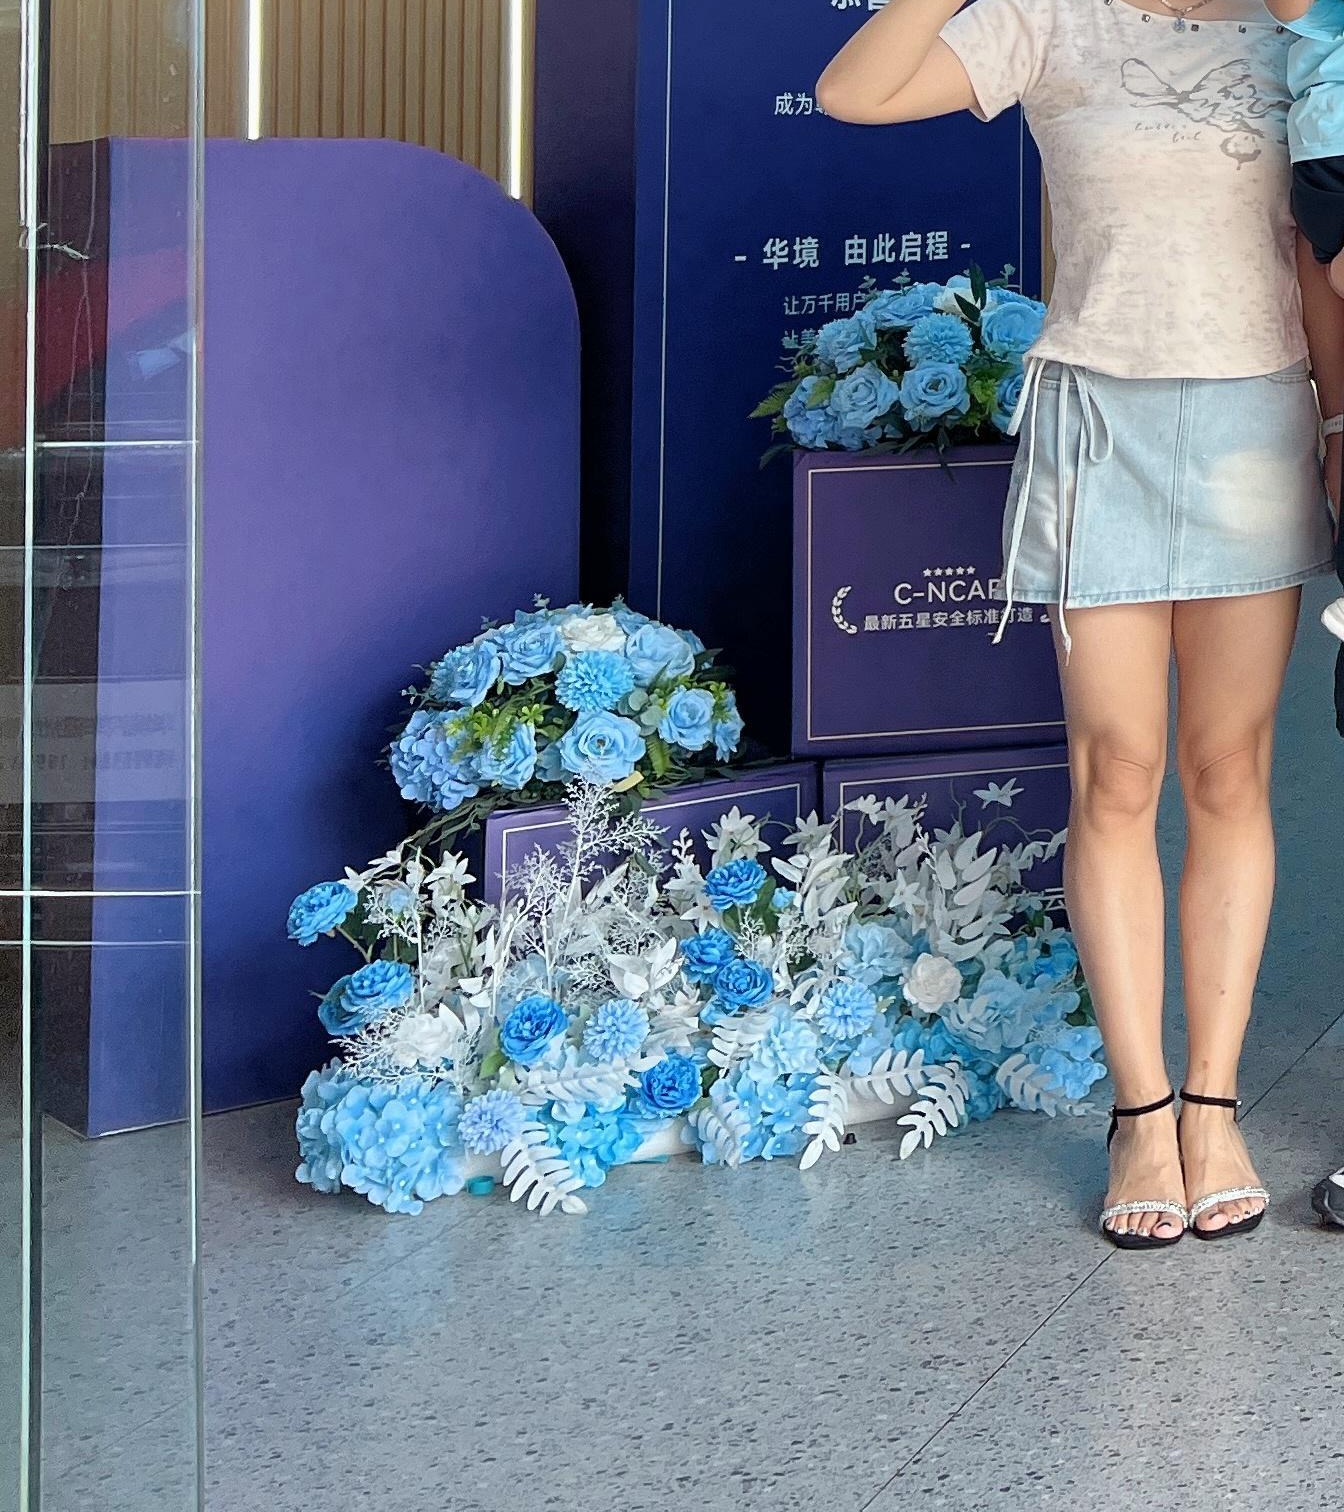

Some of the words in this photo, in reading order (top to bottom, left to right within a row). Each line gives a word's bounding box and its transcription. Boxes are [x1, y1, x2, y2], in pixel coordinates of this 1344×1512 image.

[774, 92, 829, 116] 成为
[762, 237, 819, 270] 华境
[844, 231, 948, 265] 由此启程
[783, 291, 866, 315] 让万千用户
